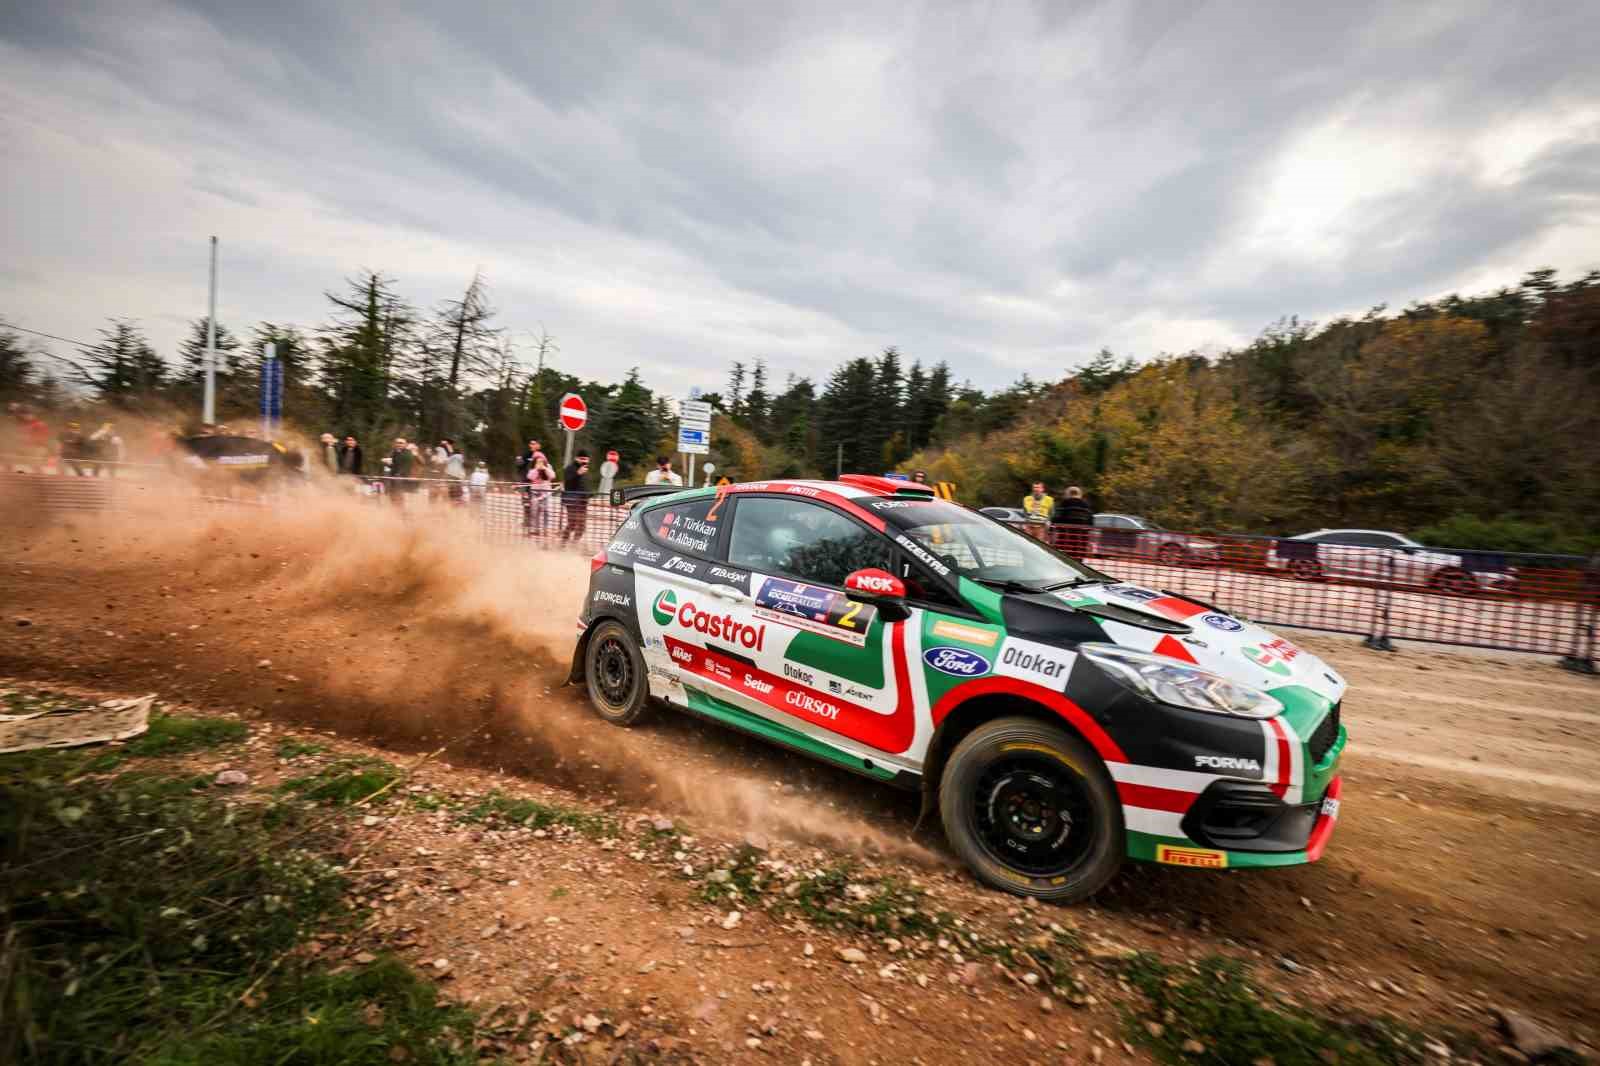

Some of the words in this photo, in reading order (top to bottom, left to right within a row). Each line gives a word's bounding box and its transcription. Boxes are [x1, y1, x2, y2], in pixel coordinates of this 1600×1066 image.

[684, 517, 717, 537] Türkkan
[675, 532, 710, 553] Albayrak
[718, 567, 747, 583] Budget
[903, 563, 909, 578] 1
[856, 575, 893, 592] NGK
[837, 601, 864, 628] 2
[677, 601, 766, 653] Castrol
[933, 649, 978, 675] Ford
[1003, 647, 1066, 679] Otokar
[743, 673, 775, 694] Setur
[785, 689, 840, 720] GÜRSOY
[1194, 755, 1261, 771] FORVIA
[1162, 848, 1221, 867] PIRELLI
